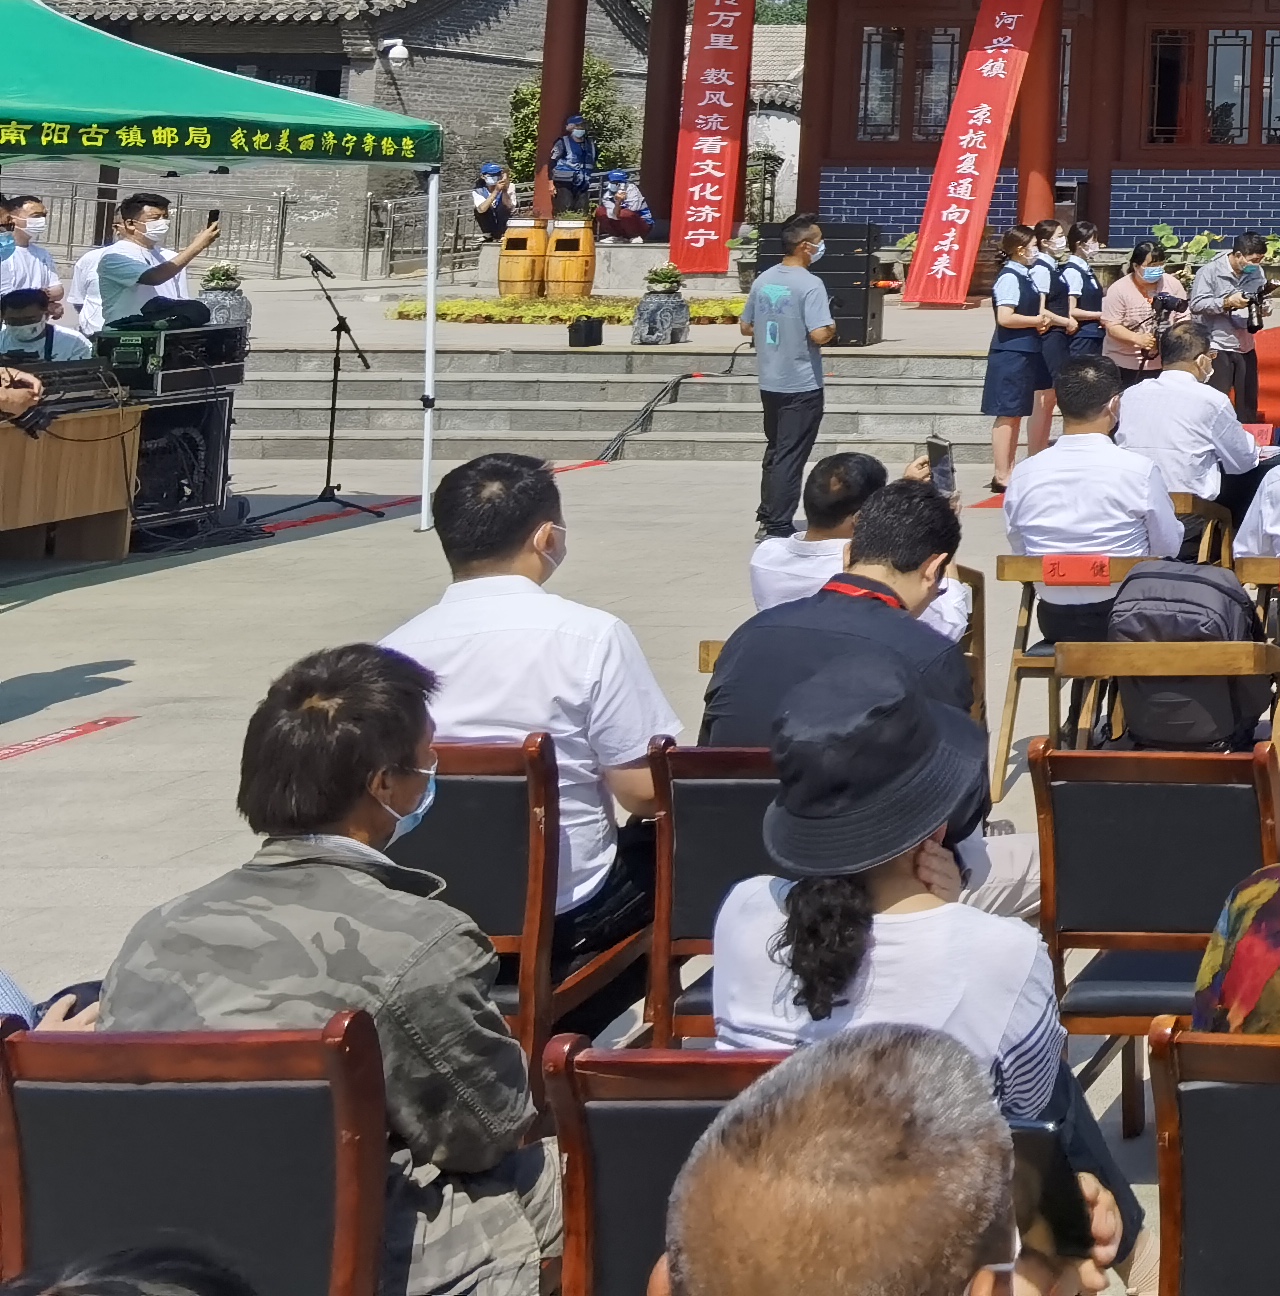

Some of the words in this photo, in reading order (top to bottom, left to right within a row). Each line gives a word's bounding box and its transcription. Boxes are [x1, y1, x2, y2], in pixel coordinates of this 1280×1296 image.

[0, 120, 212, 149] 南阳古镇邮局
[229, 126, 417, 159] 我把美丽济宁寄给您
[684, 67, 735, 248] 数风流看文化济宁
[928, 103, 992, 279] 京杭复通向未来
